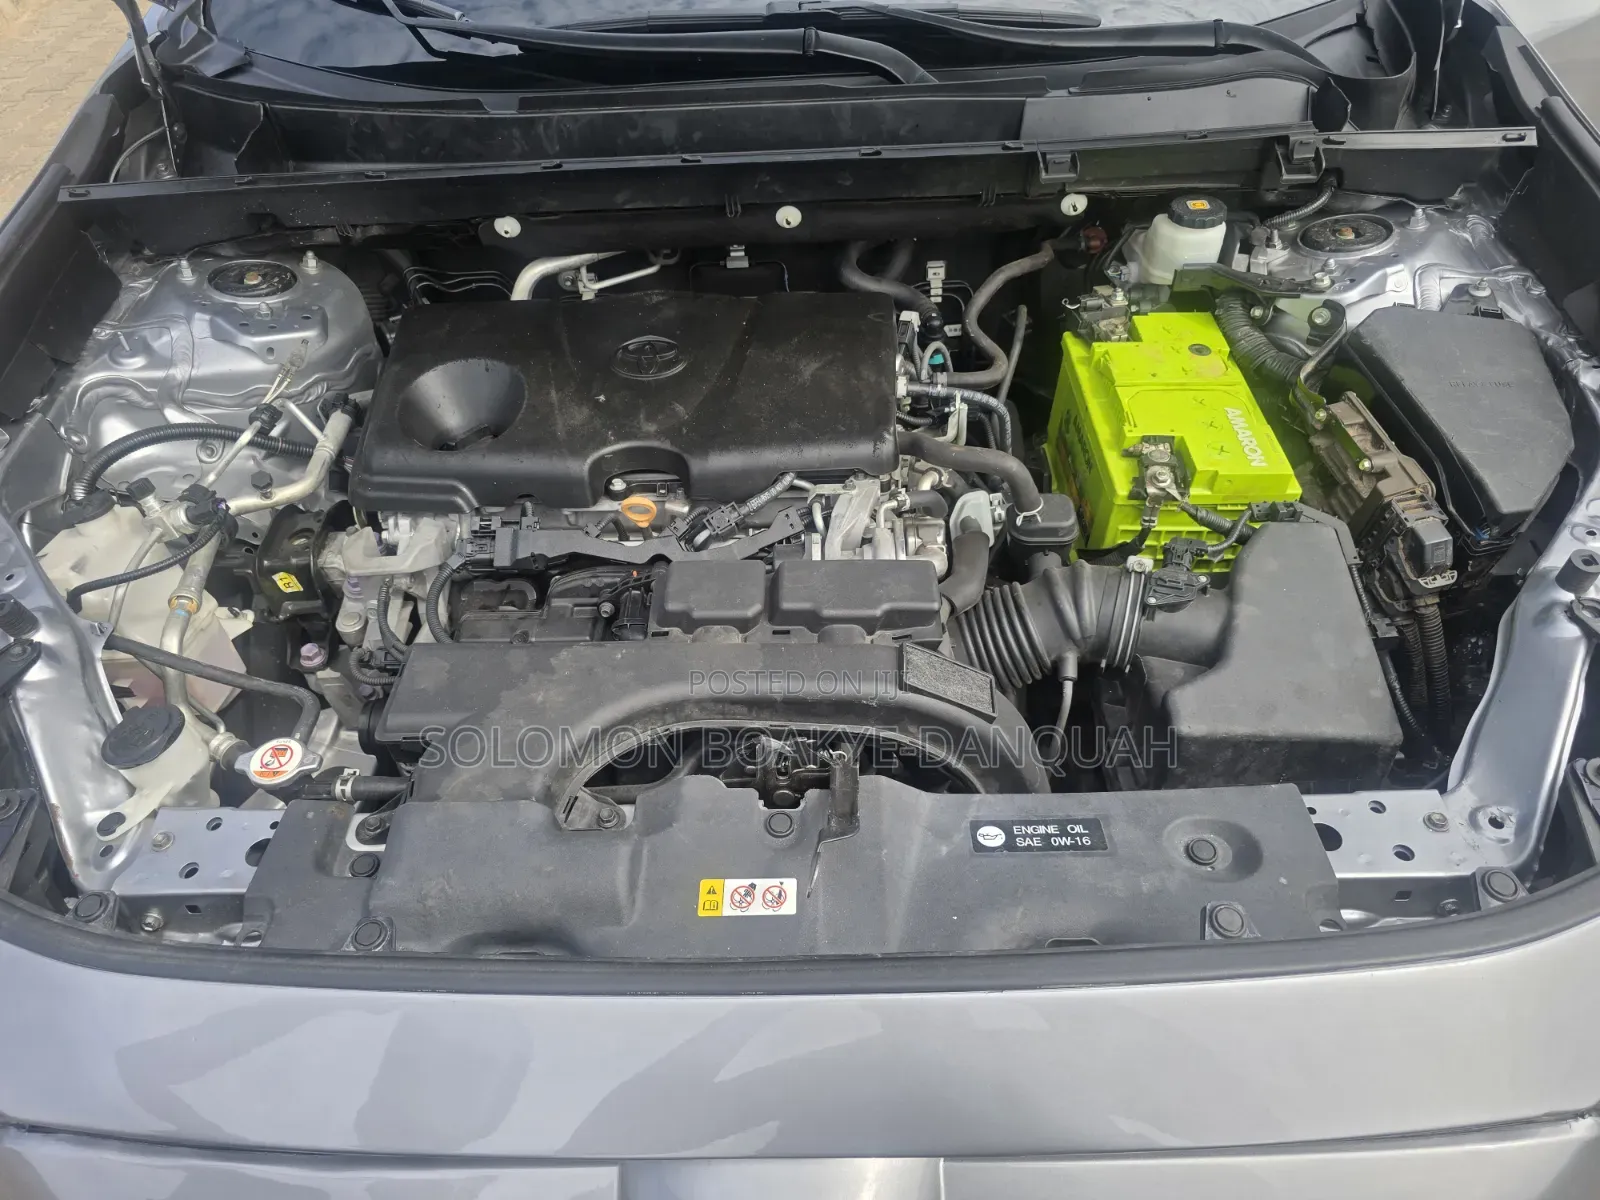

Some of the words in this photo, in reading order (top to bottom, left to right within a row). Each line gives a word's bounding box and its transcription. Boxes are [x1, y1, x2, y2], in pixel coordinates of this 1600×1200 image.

[1223, 407, 1268, 467] AMARON
[1012, 825, 1060, 835] ENGINE
[1066, 824, 1089, 834] OIL
[1015, 837, 1043, 847] SAE
[1050, 836, 1092, 846] 0W-16
